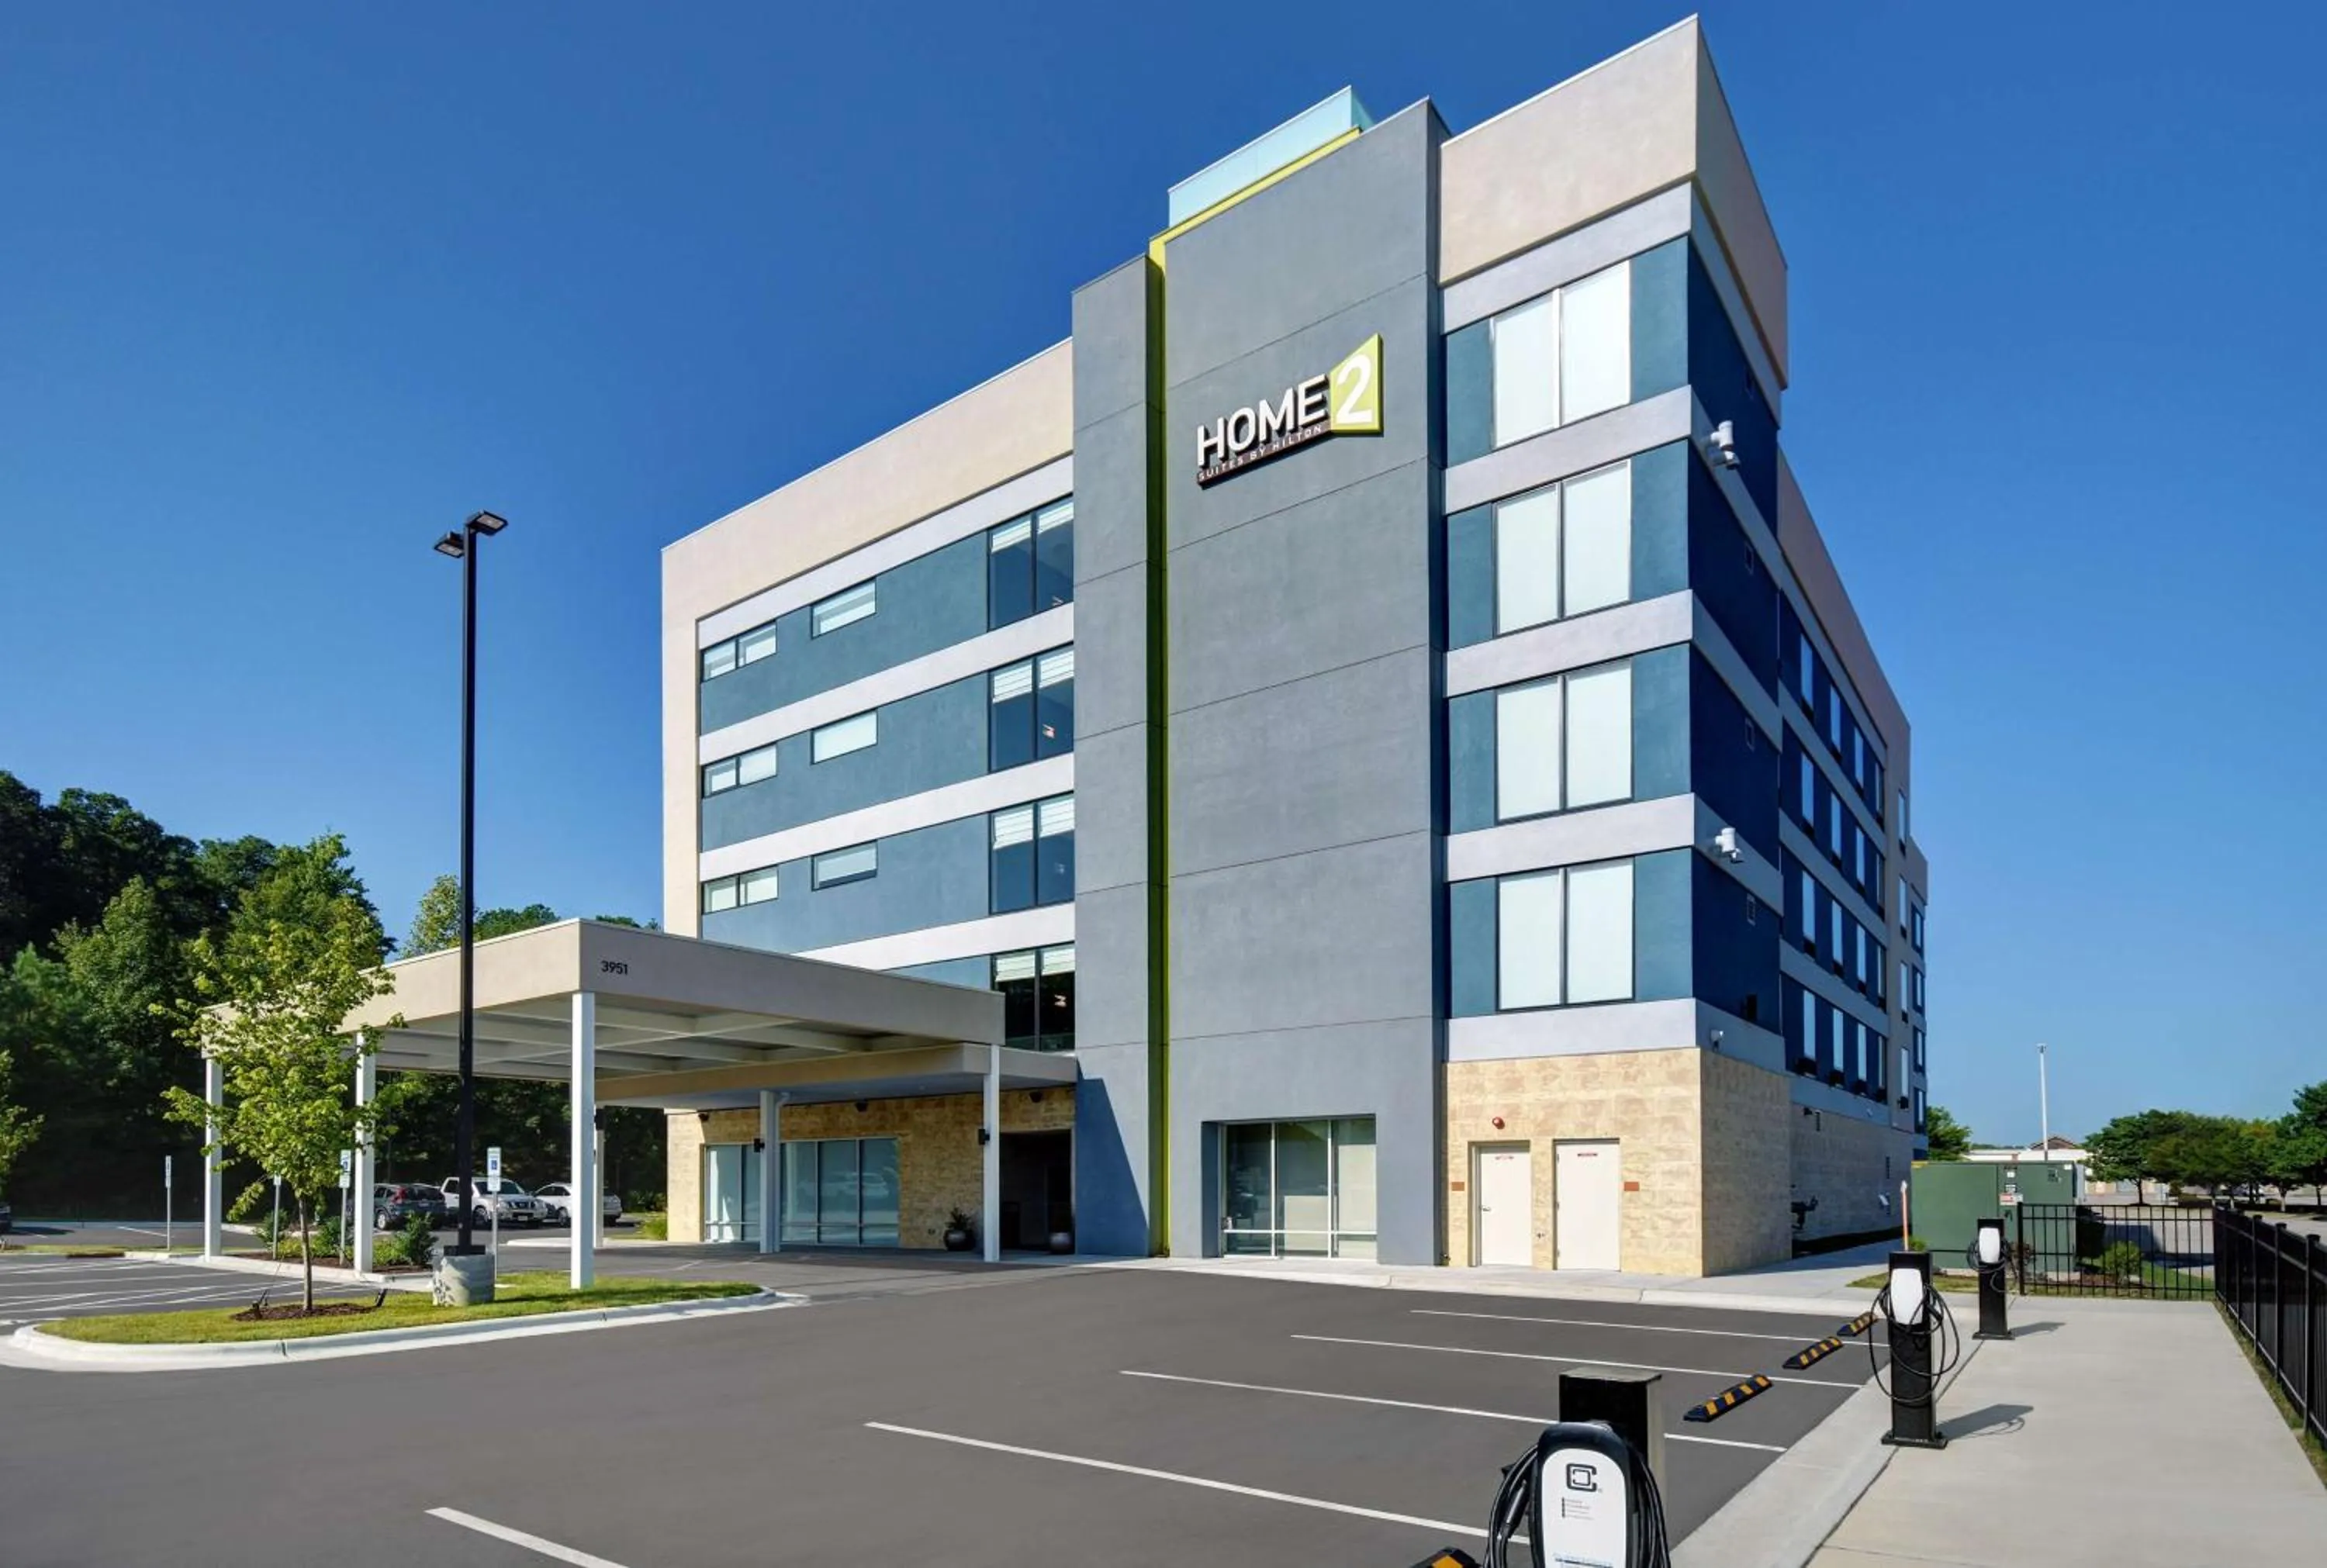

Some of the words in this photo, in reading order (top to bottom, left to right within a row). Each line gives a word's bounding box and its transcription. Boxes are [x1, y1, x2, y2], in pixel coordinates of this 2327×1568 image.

[1196, 373, 1326, 467] HOME
[1336, 354, 1373, 424] 2
[1198, 456, 1244, 482] SUITES
[1250, 445, 1266, 460] BY
[1272, 425, 1323, 451] HILTON
[600, 960, 628, 975] 3951
